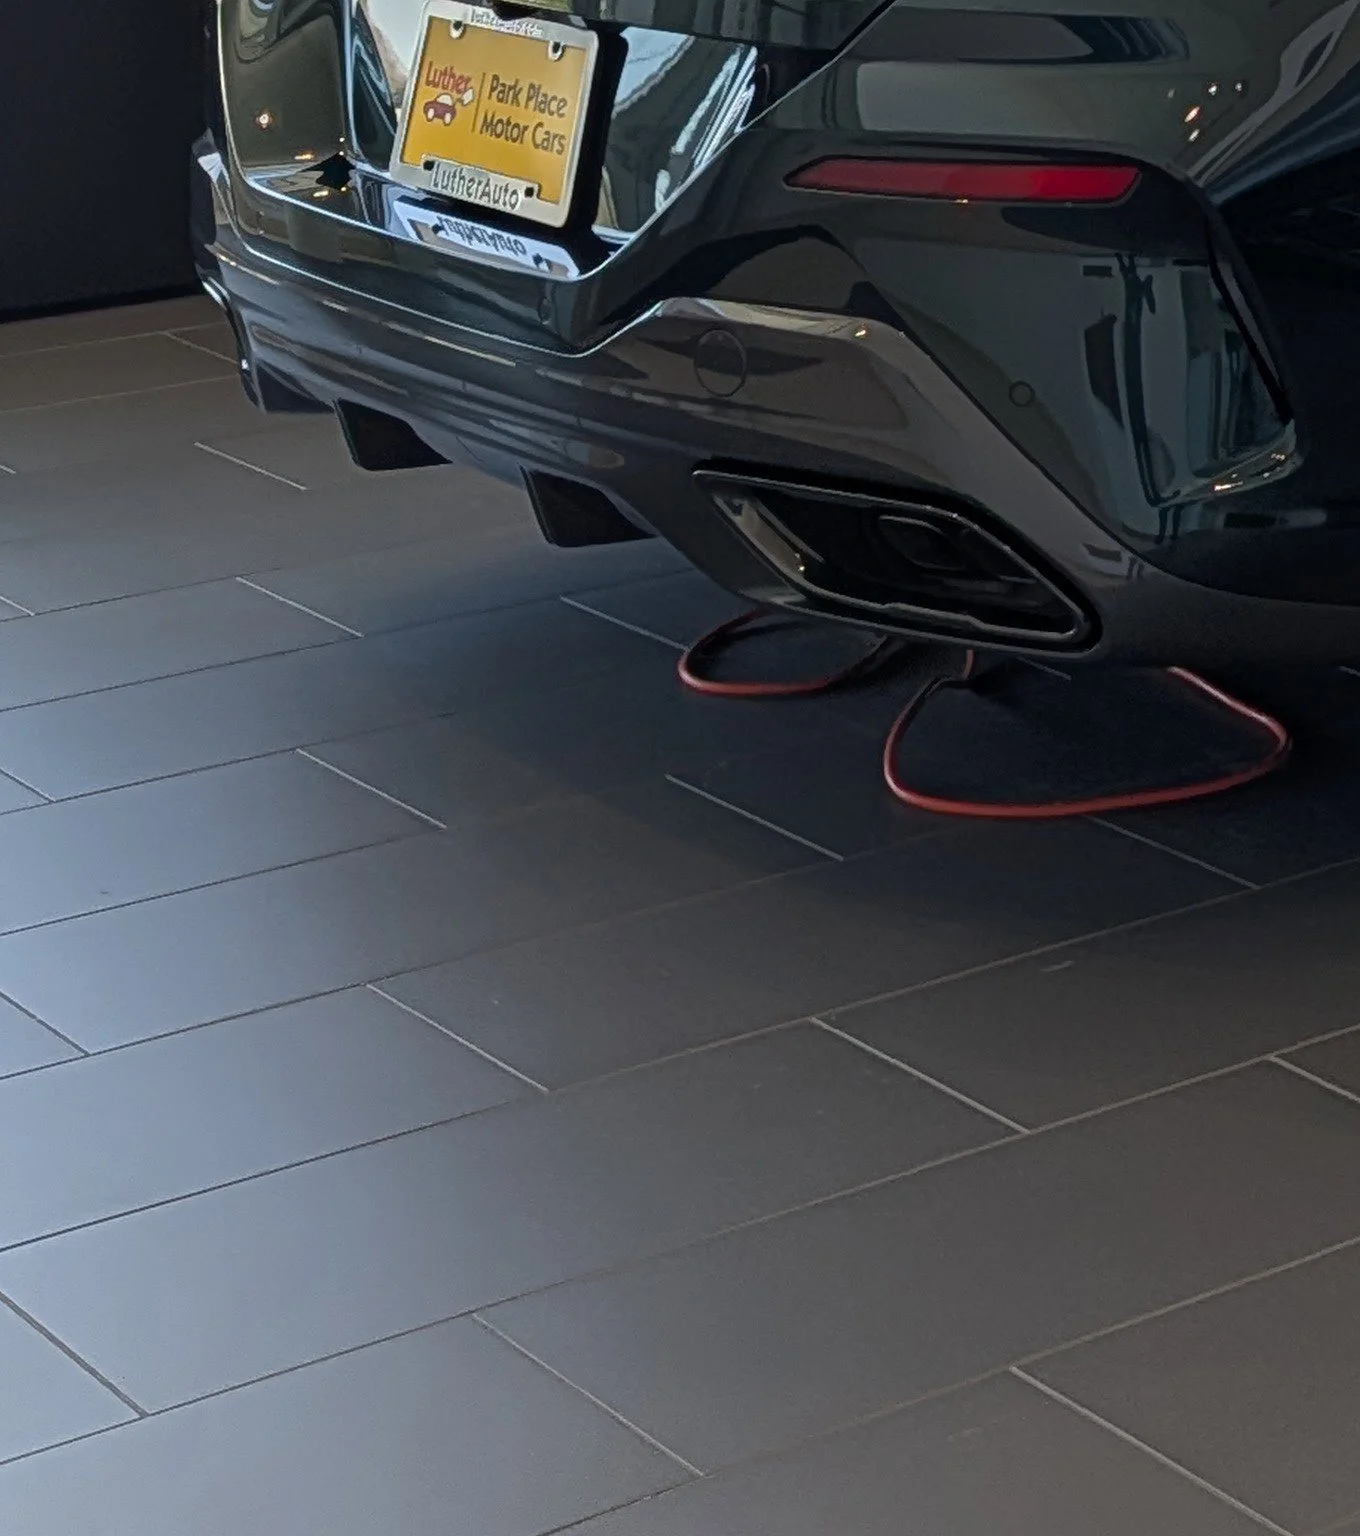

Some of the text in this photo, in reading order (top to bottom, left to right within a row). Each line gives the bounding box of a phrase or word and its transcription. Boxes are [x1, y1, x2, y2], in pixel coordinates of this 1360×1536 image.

[425, 61, 473, 94] Luther
[487, 74, 568, 118] Park Place
[479, 112, 567, 155] Motor Cars
[431, 165, 521, 210] LutherAuto
